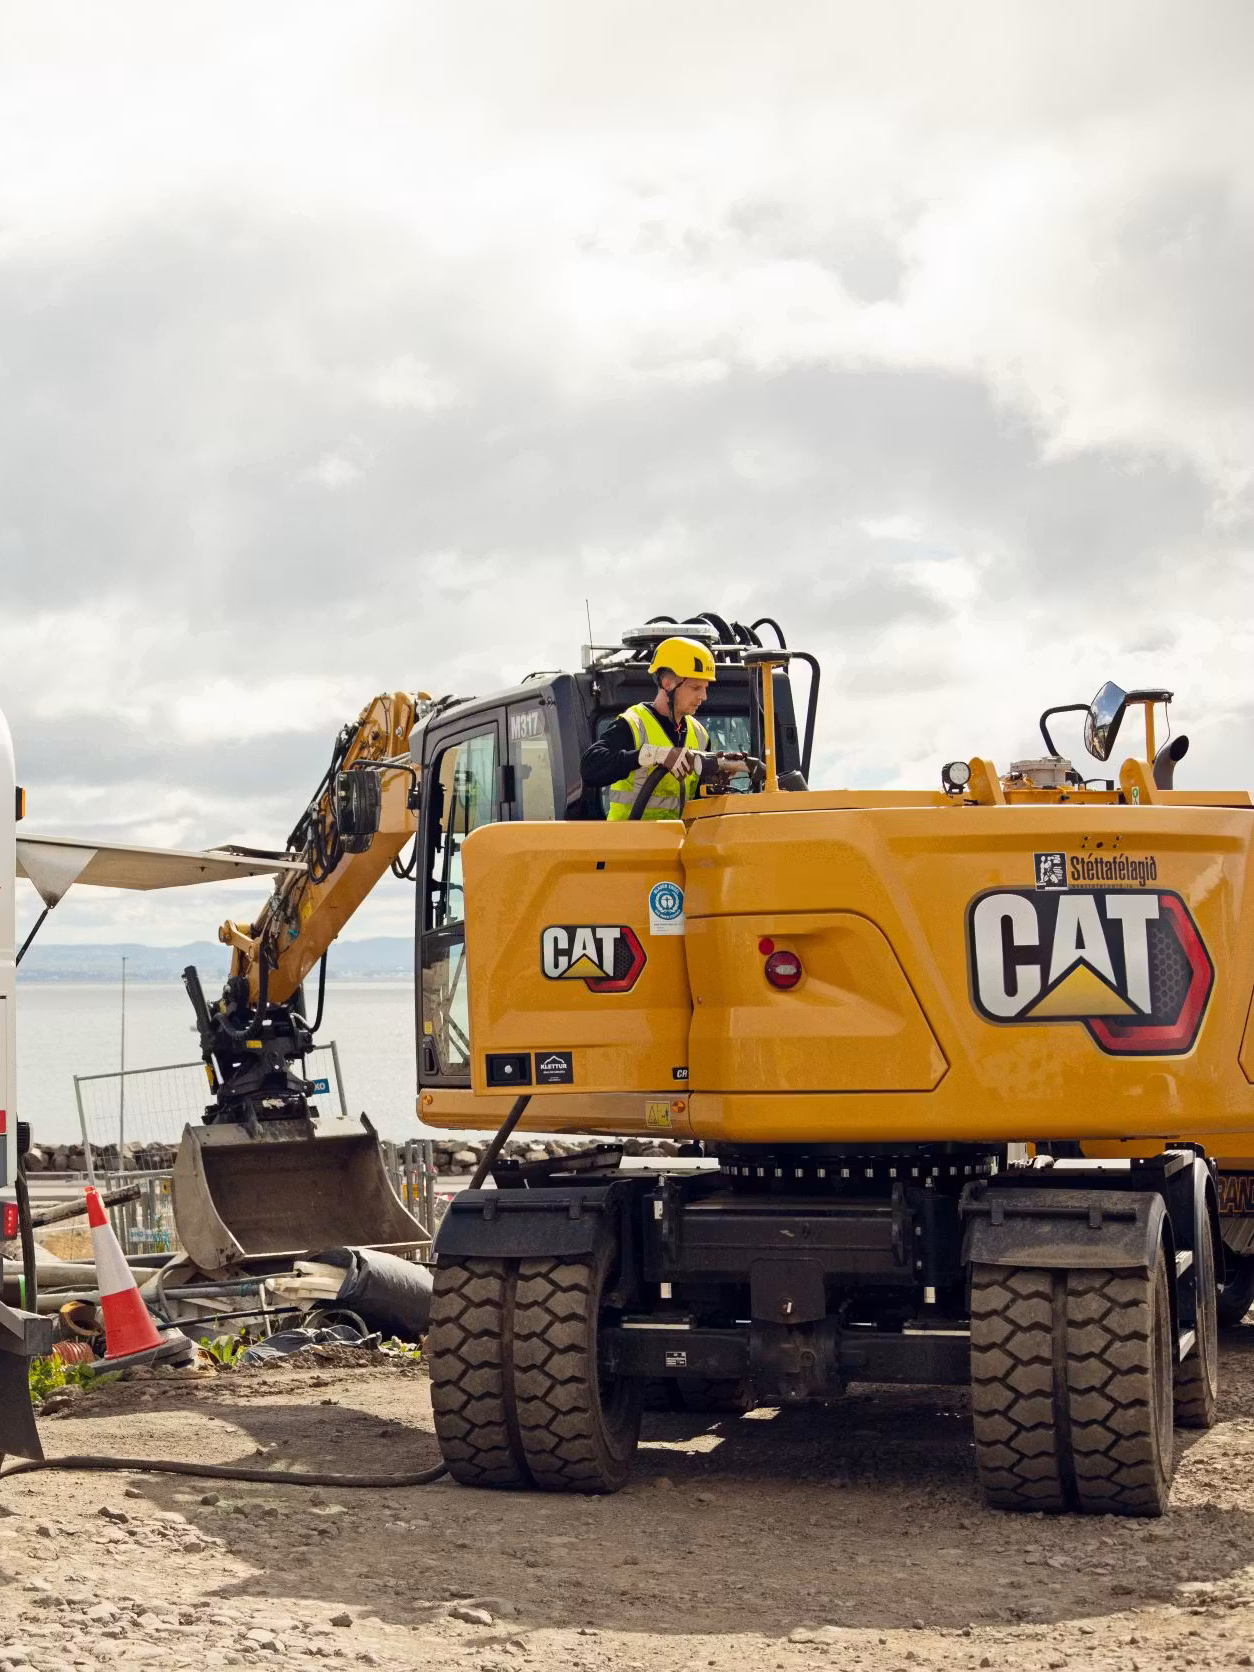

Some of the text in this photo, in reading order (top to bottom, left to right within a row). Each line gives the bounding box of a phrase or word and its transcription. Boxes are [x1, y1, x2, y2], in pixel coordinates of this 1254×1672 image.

[511, 712, 538, 740] M317
[1070, 853, 1157, 887] Stéttafélagið
[543, 927, 620, 978] CAT
[974, 893, 1159, 1017] CAT
